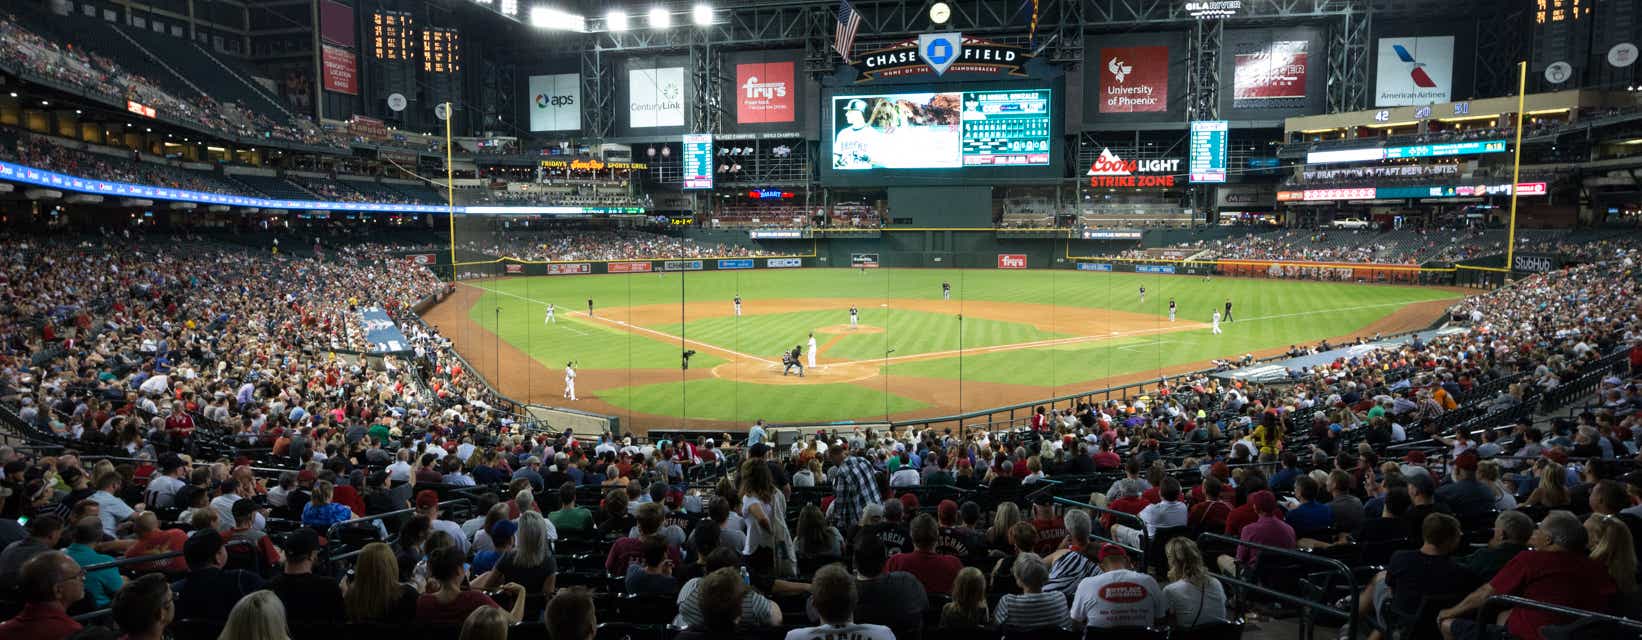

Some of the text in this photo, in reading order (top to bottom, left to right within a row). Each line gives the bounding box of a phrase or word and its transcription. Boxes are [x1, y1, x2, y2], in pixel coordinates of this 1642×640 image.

[1186, 1, 1241, 10] GILA RIVER
[866, 49, 1016, 68] CHASE FIELD
[743, 76, 786, 99] fry's
[1108, 85, 1153, 95] University
[551, 94, 574, 108] aps
[631, 102, 681, 112] CenturyLink
[1108, 97, 1154, 105] of Phoenix
[1375, 103, 1469, 121] 42 20 51
[1091, 155, 1180, 173] Coors LIGHT
[1091, 175, 1175, 187] STRIKE ZONE
[1515, 256, 1551, 272] StubHub
